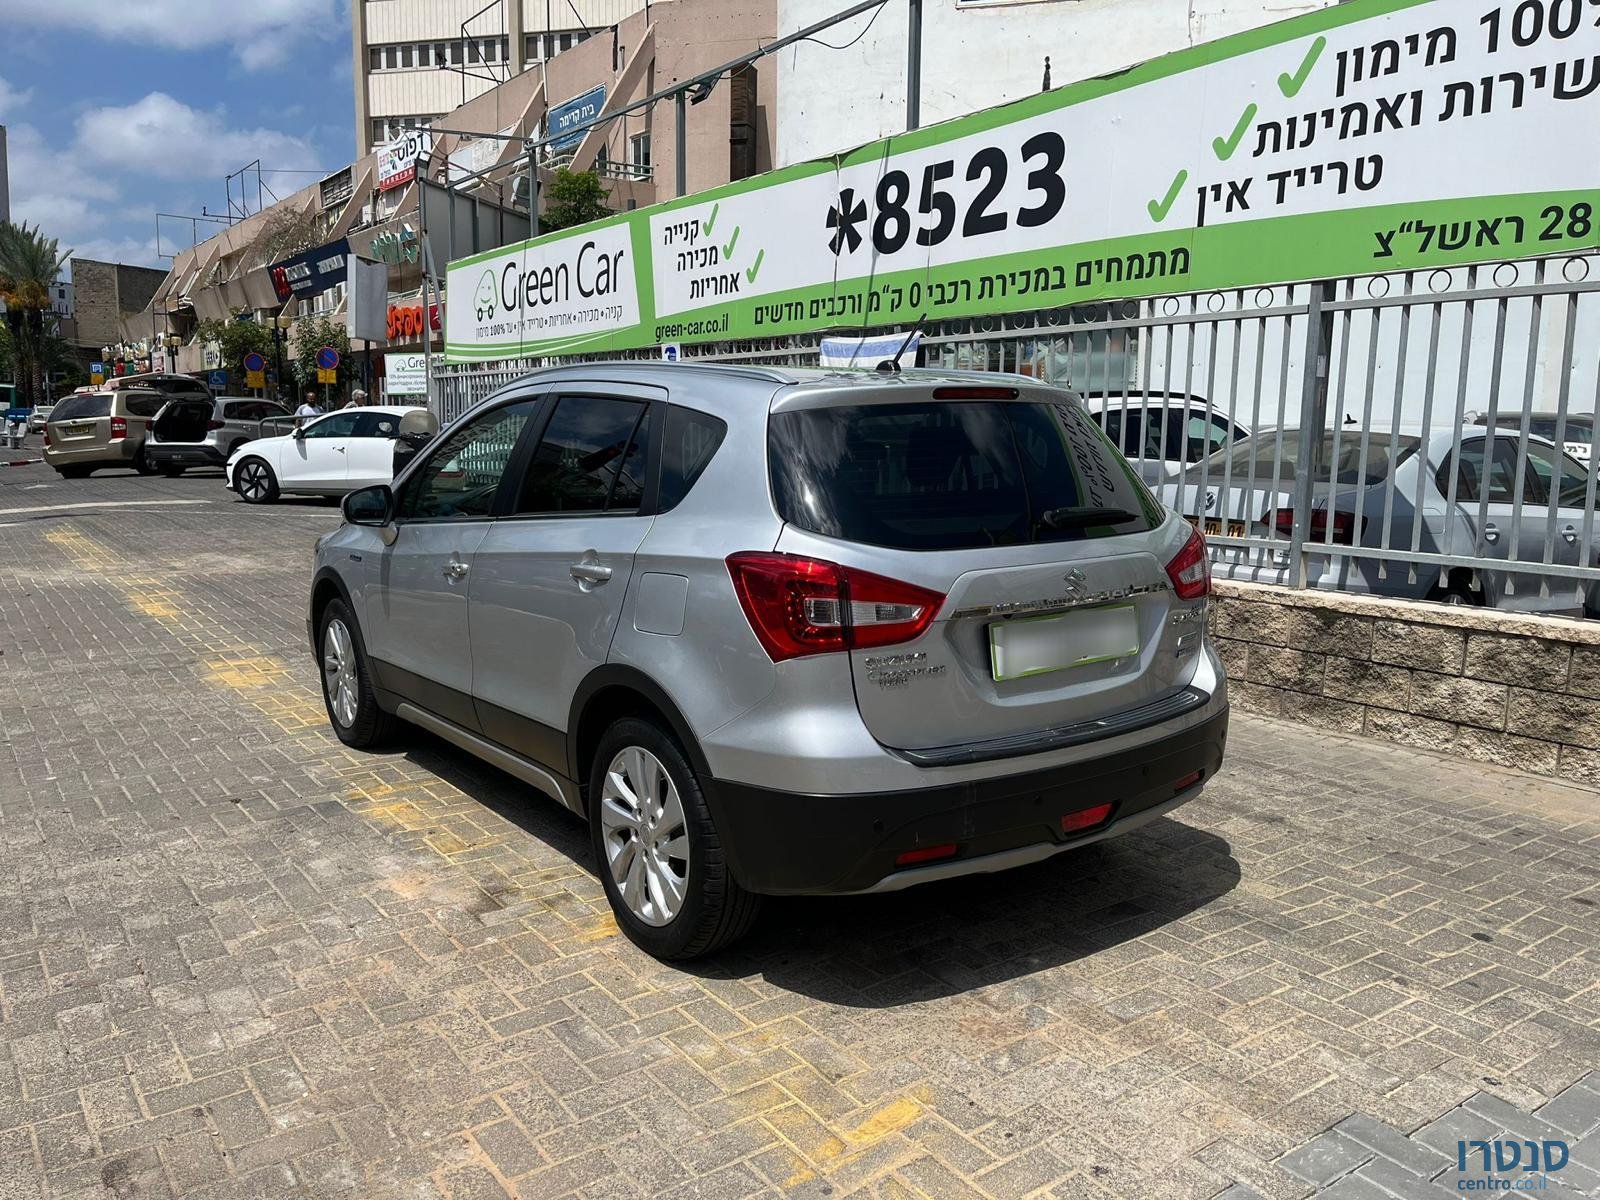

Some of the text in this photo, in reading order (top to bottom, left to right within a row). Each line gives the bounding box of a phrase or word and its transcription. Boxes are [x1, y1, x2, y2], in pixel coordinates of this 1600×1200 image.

[1335, 0, 1600, 98] 100 מימון
[559, 103, 595, 129] בית קדימה
[1253, 55, 1600, 158] שירות ואמינות
[1196, 153, 1384, 228] טרייד אין
[664, 219, 700, 246] קנייה
[1373, 202, 1592, 259] 28 ראשל"צ
[677, 245, 719, 272] מכירה
[500, 241, 625, 313] Green Car
[690, 271, 740, 300] אחריות
[754, 246, 1190, 325] מתמחים במכירת רכבי 0 ק"מ ורכבים חדשים
[527, 316, 543, 331] טרייד
[549, 313, 572, 327] אחריות
[578, 308, 599, 323] מכירה
[605, 305, 623, 322] קניה
[655, 313, 729, 342] green-car.co.il
[490, 325, 505, 336] 100%
